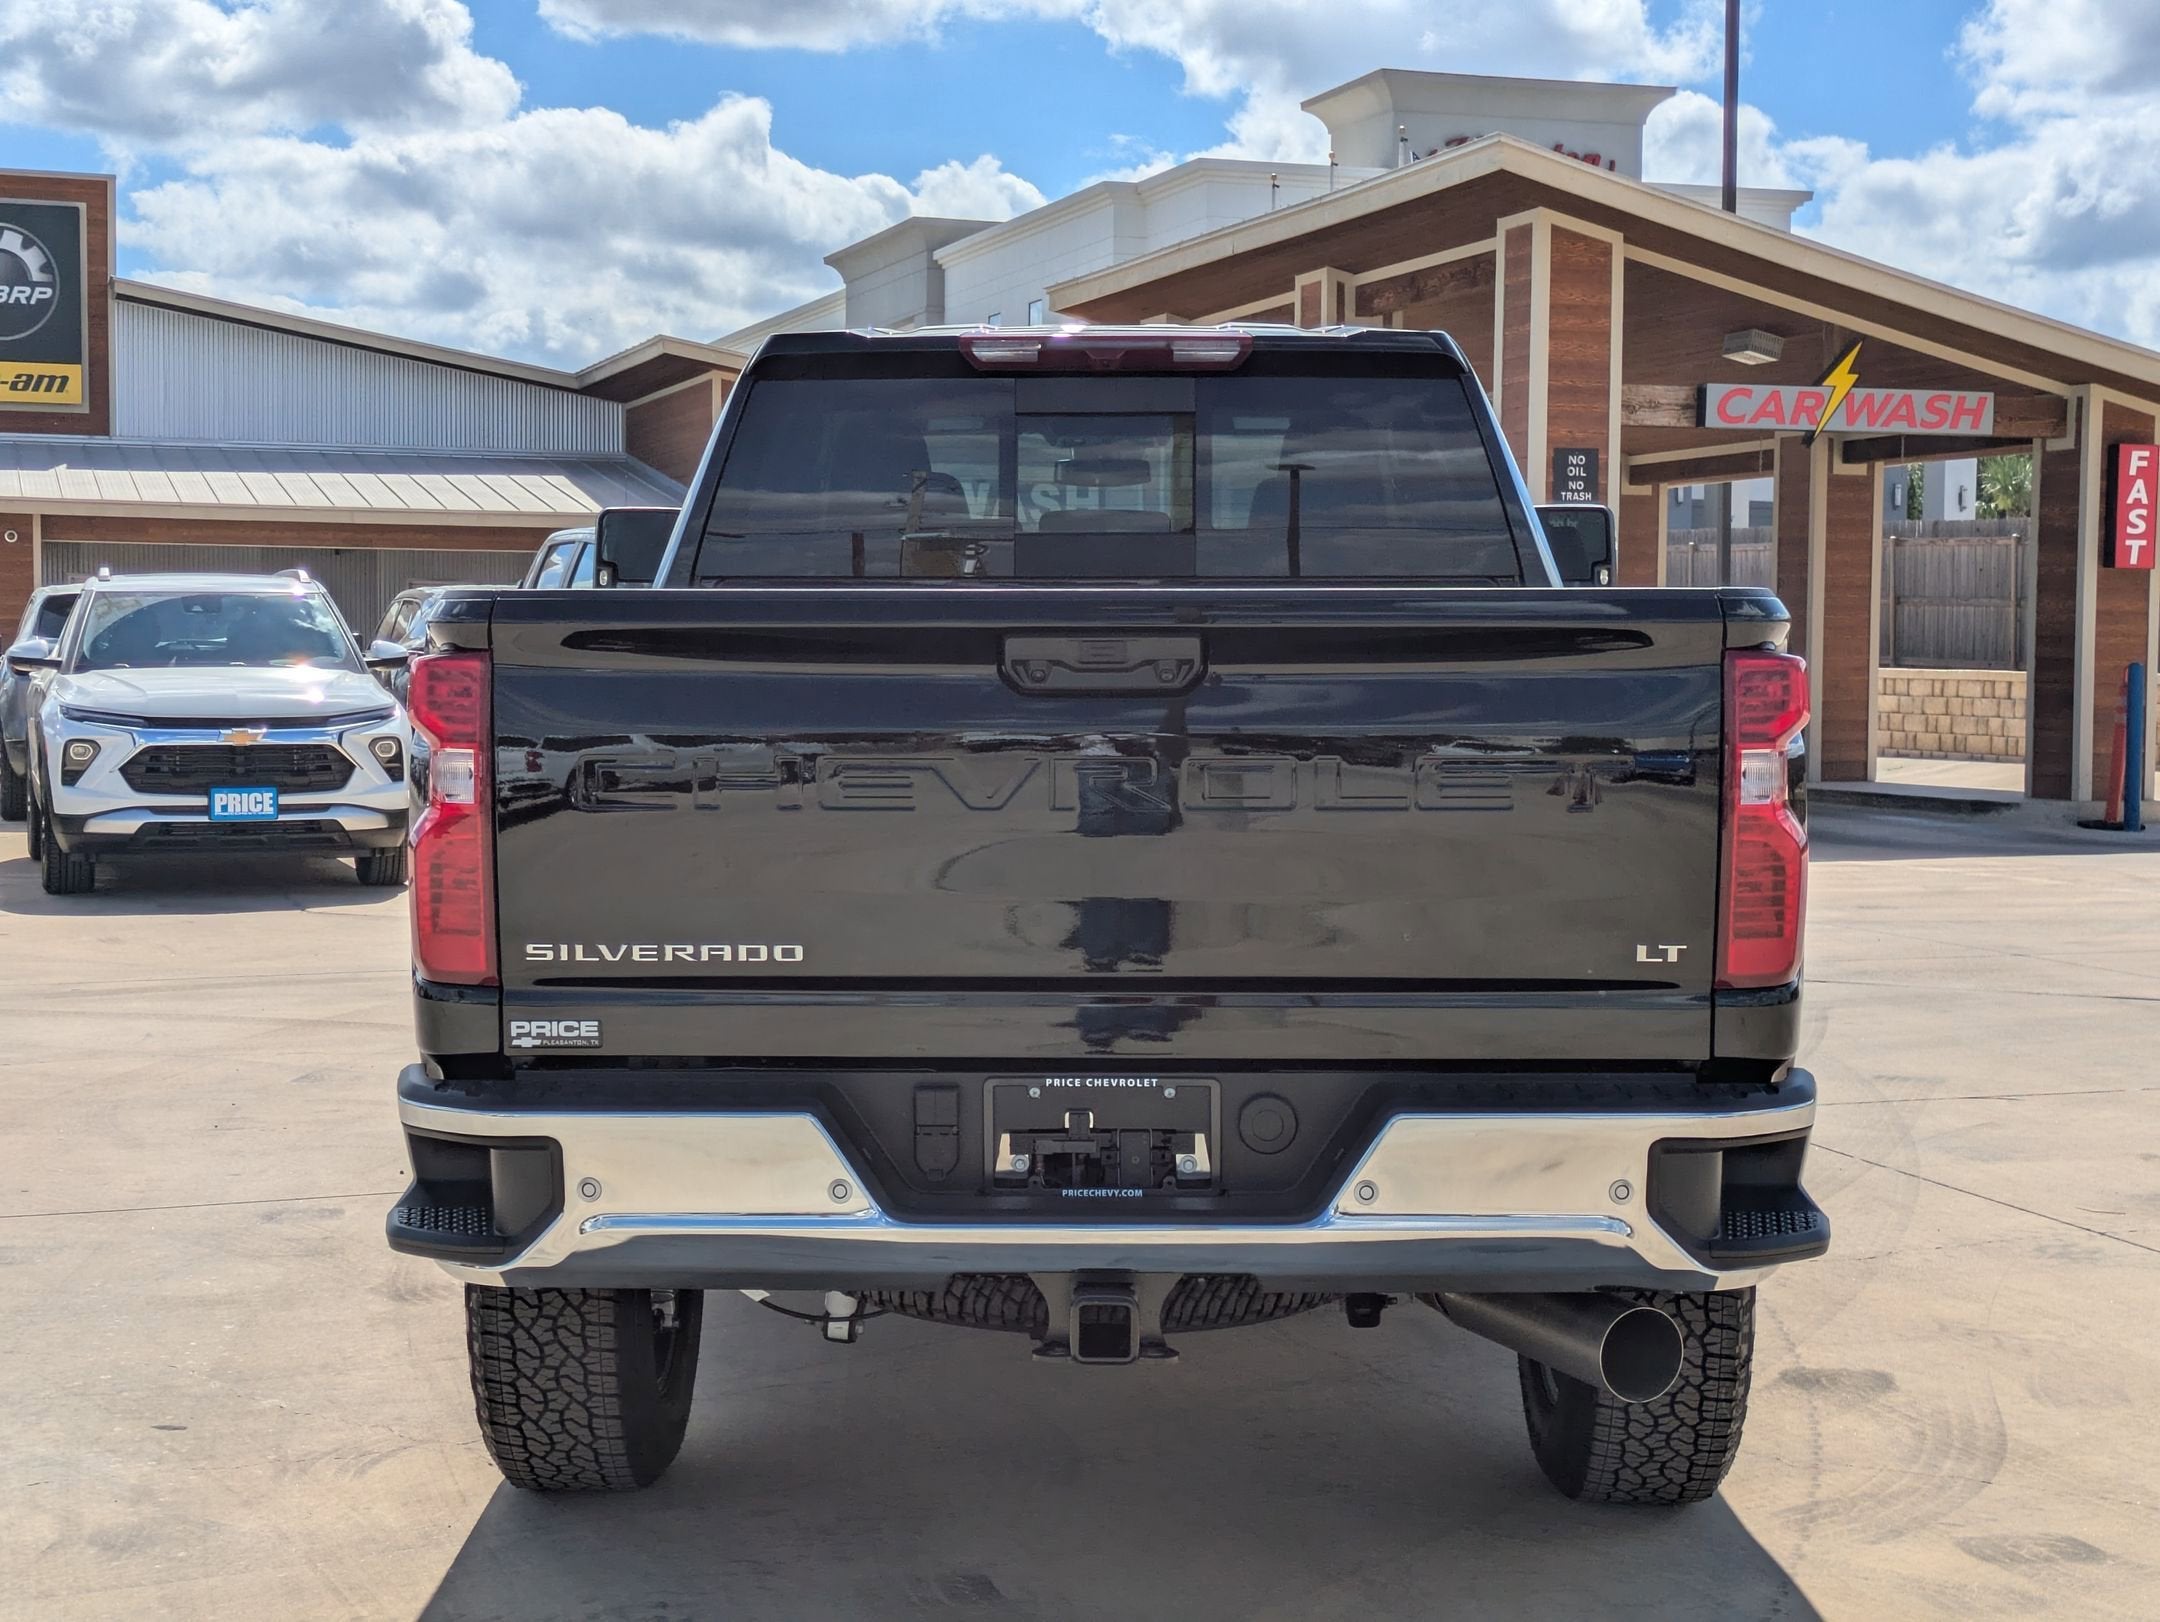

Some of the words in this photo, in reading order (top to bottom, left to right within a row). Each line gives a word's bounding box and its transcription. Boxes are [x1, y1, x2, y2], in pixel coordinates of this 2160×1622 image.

[1717, 387, 1827, 426] CAR
[1843, 392, 1988, 431] WASH
[1568, 455, 1586, 465] NO
[1567, 466, 1587, 477] OIL
[1568, 481, 1585, 490] NO
[1560, 491, 1592, 501] TRASH
[2125, 450, 2150, 565] FAST
[574, 753, 1634, 813] CHEVROLET
[214, 792, 274, 812] PRICE
[525, 943, 805, 962] SILVERADO
[1636, 944, 1687, 962] LT
[510, 1020, 599, 1037] PRICE
[1045, 1078, 1081, 1087] PRICE
[1086, 1078, 1159, 1087] CHEVROLET
[1062, 1189, 1143, 1198] PRICECHEVY.COM
